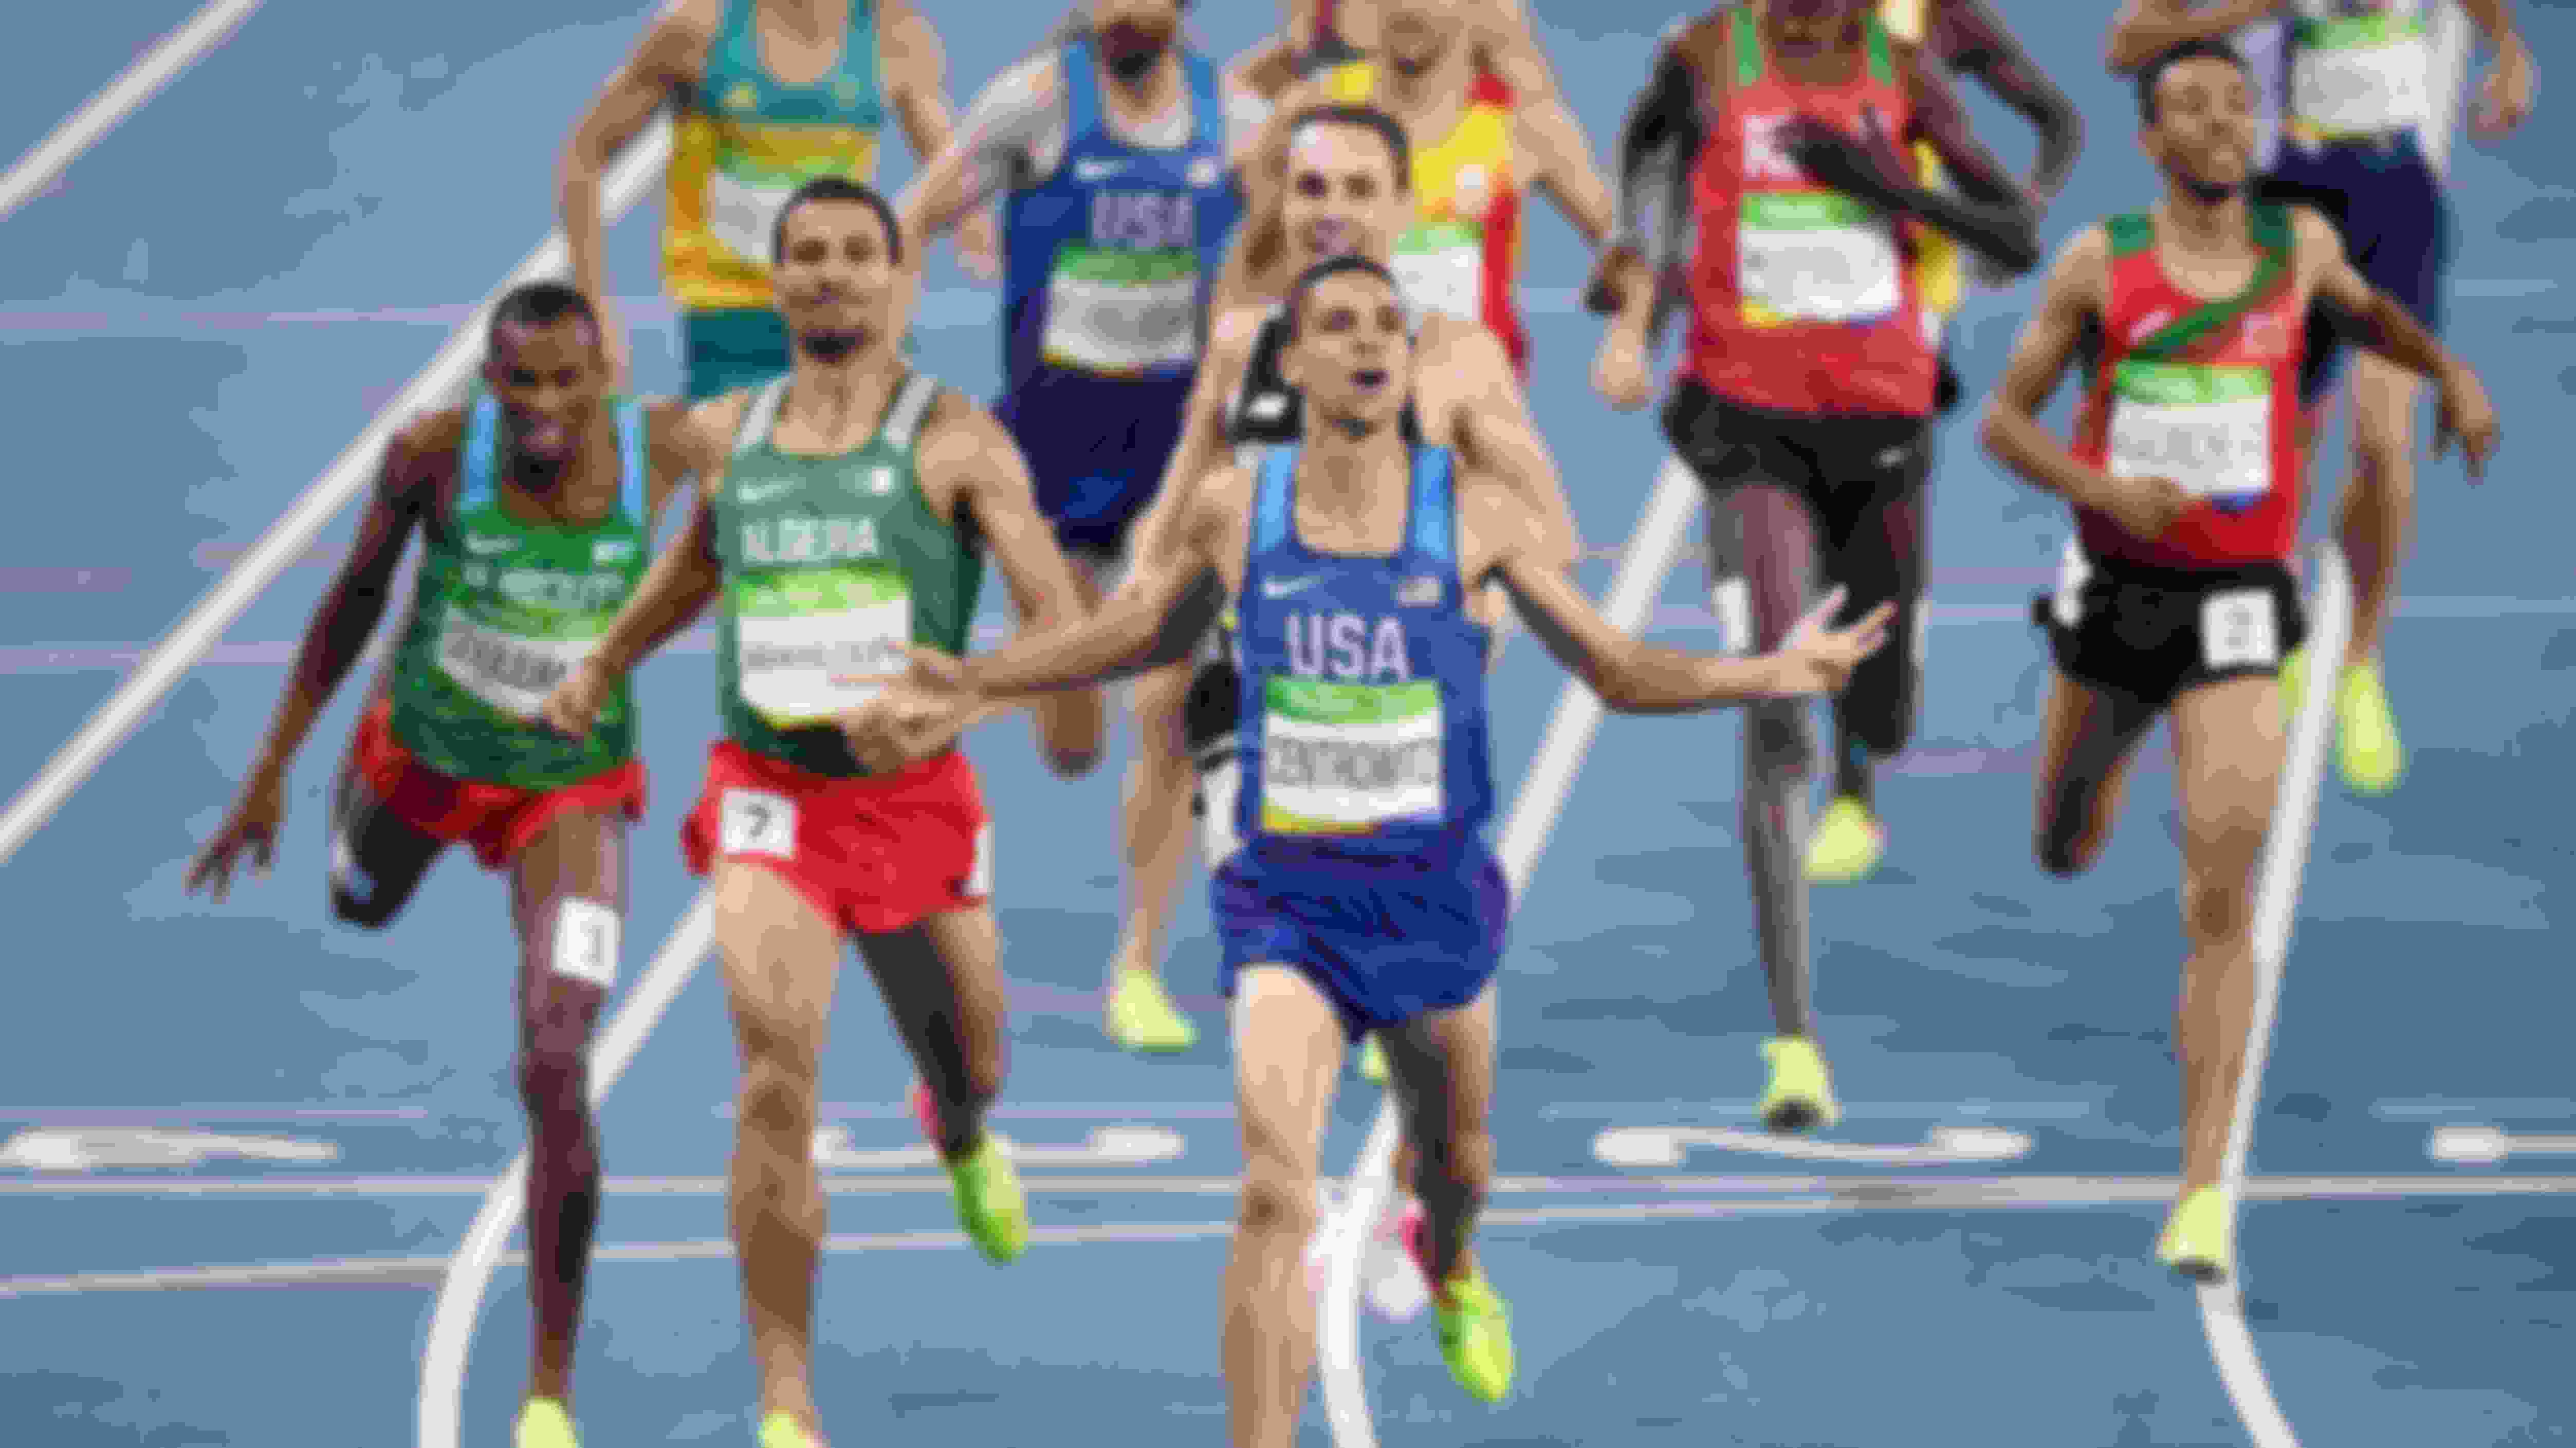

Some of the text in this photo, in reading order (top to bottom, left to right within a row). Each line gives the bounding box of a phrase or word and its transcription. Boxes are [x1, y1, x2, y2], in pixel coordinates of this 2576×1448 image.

[1091, 190, 1195, 248] USA
[1286, 614, 1413, 679] USA
[745, 802, 773, 842] 7
